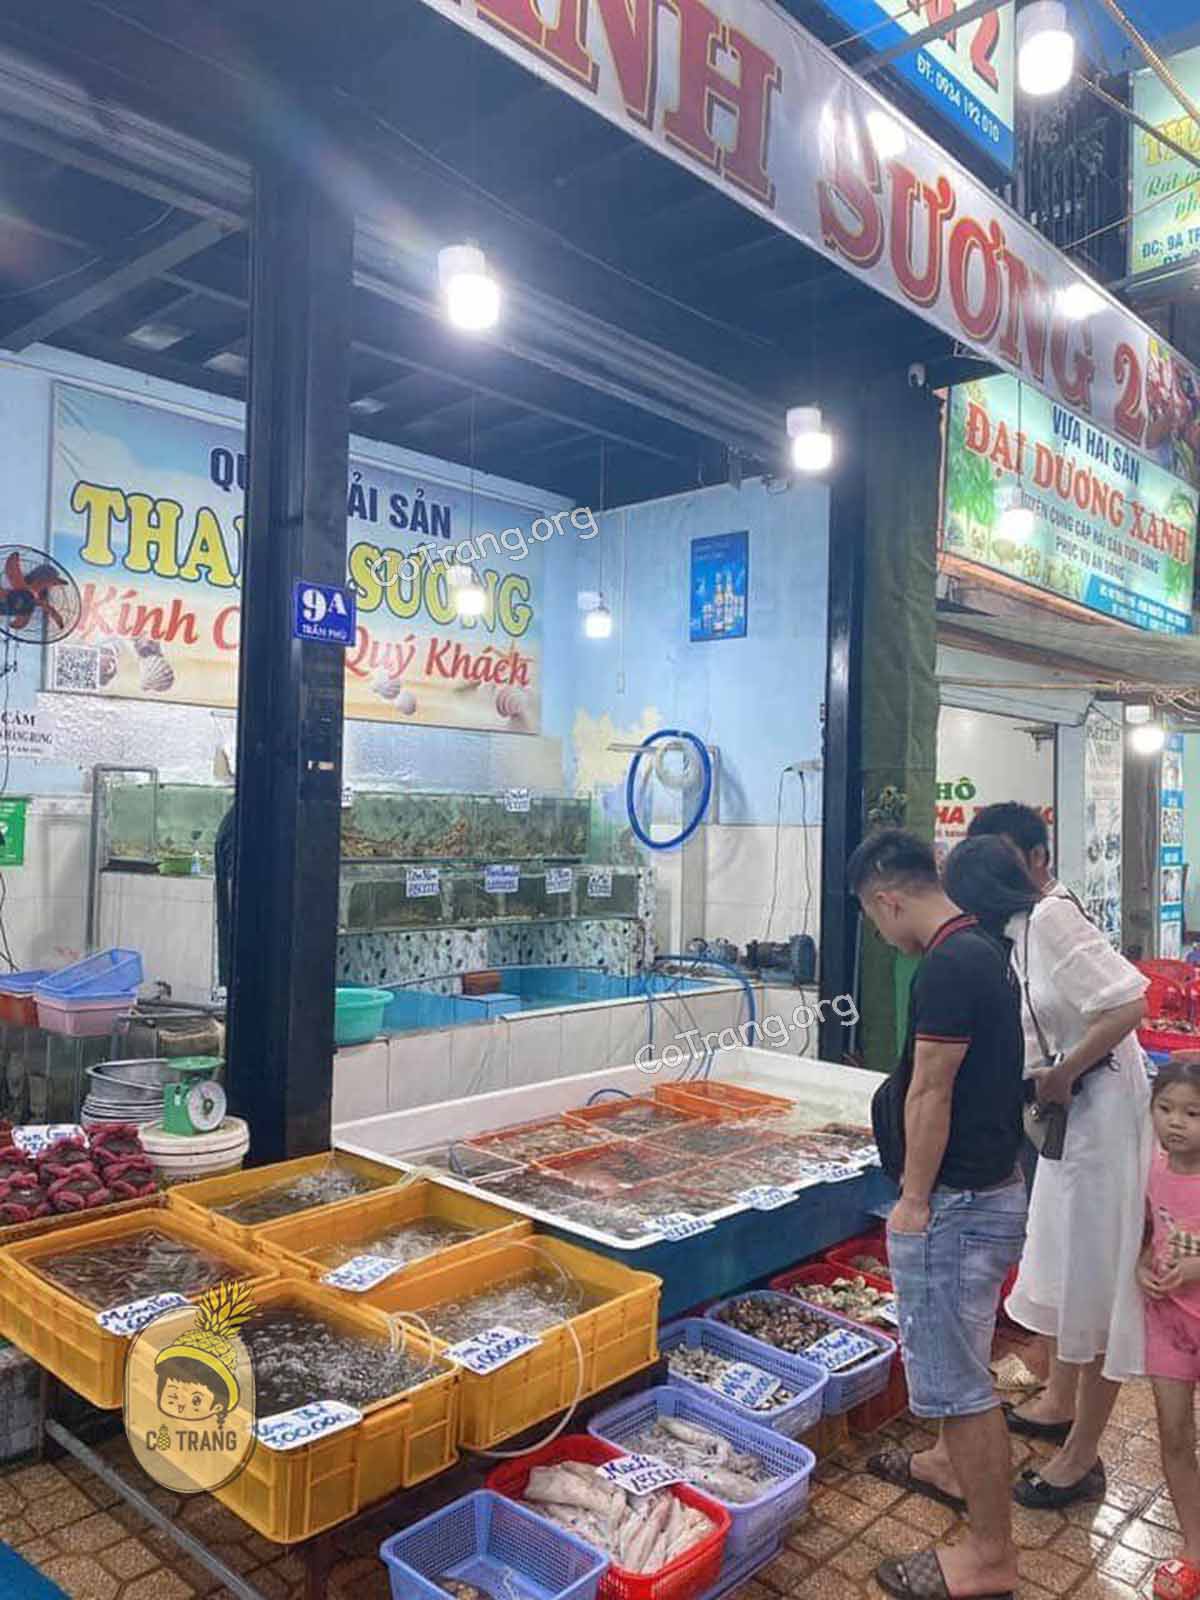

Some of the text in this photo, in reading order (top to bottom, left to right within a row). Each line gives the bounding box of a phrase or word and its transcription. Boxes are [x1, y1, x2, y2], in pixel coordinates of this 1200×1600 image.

[448, 0, 784, 210] NH
[1113, 342, 1148, 445] 2
[71, 480, 245, 588] THA
[210, 447, 451, 539] QU ẢI SẢN
[965, 401, 1189, 565] ĐẠI DƯƠNG XANH
[75, 583, 198, 646] Kính
[345, 626, 415, 678] Quý
[426, 637, 531, 687] Khách
[303, 589, 348, 622] 9A
[936, 776, 977, 801] HÔ
